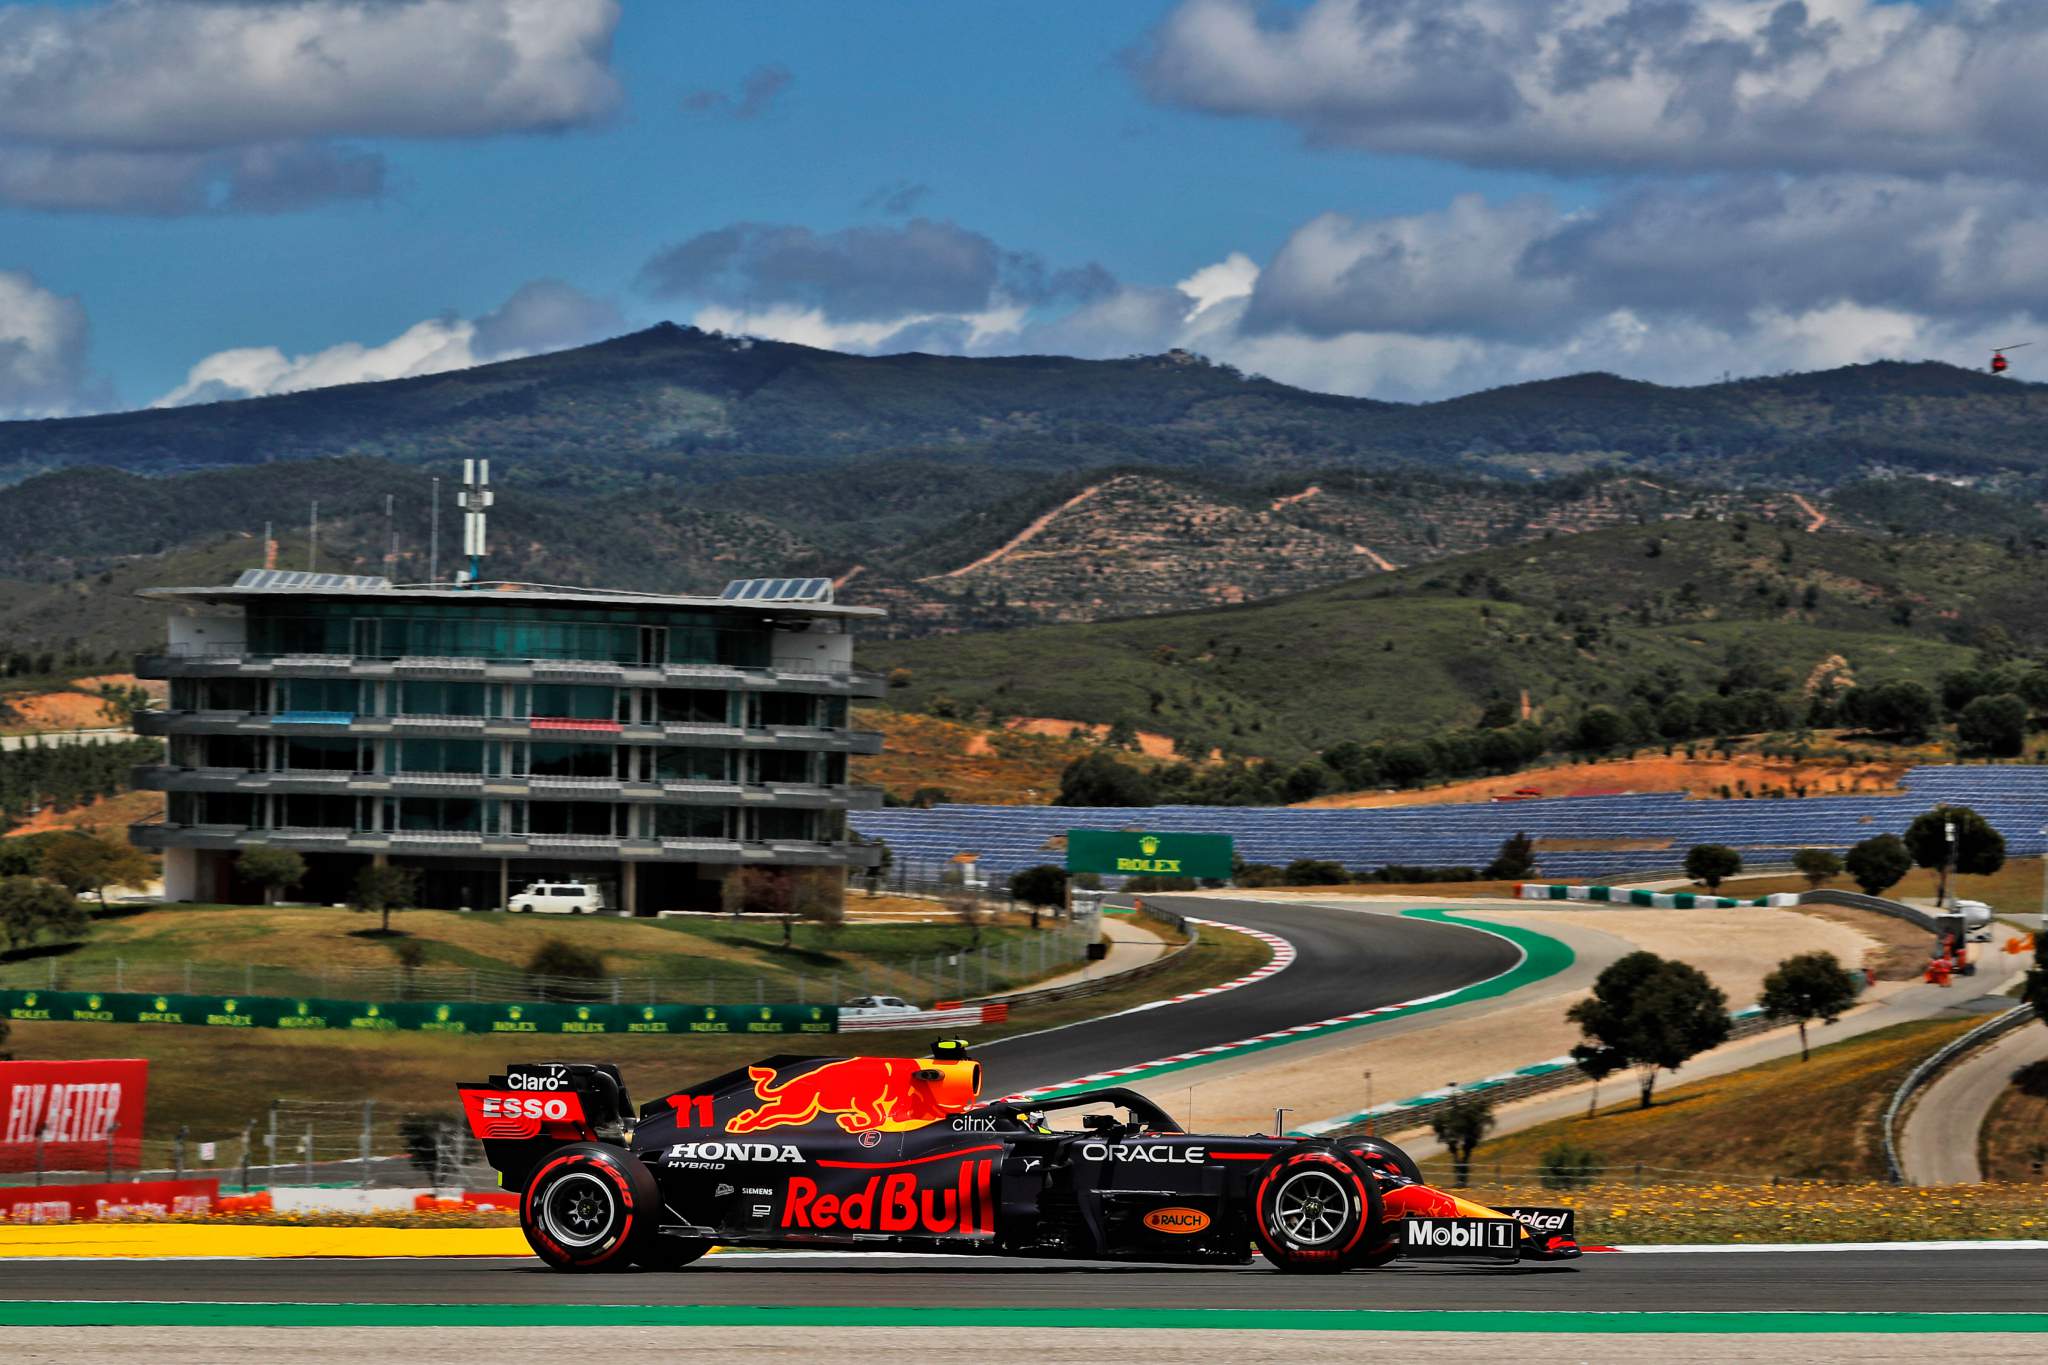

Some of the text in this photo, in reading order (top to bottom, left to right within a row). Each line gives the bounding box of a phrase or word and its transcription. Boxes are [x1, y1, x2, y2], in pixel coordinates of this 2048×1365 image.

[1117, 858, 1181, 872] ROLEX
[507, 1072, 560, 1092] Claro
[5, 1082, 121, 1143] FLY BETTER
[482, 1098, 568, 1119] ESSO
[665, 1094, 714, 1128] 11
[952, 1114, 997, 1132] citrix
[668, 1142, 806, 1163] HONDA
[1082, 1143, 1205, 1164] ORACLE
[667, 1160, 726, 1170] HYBRID
[741, 1187, 773, 1196] SIEMENS
[1160, 1215, 1201, 1226] RAUCH
[1408, 1220, 1483, 1247] Mobil
